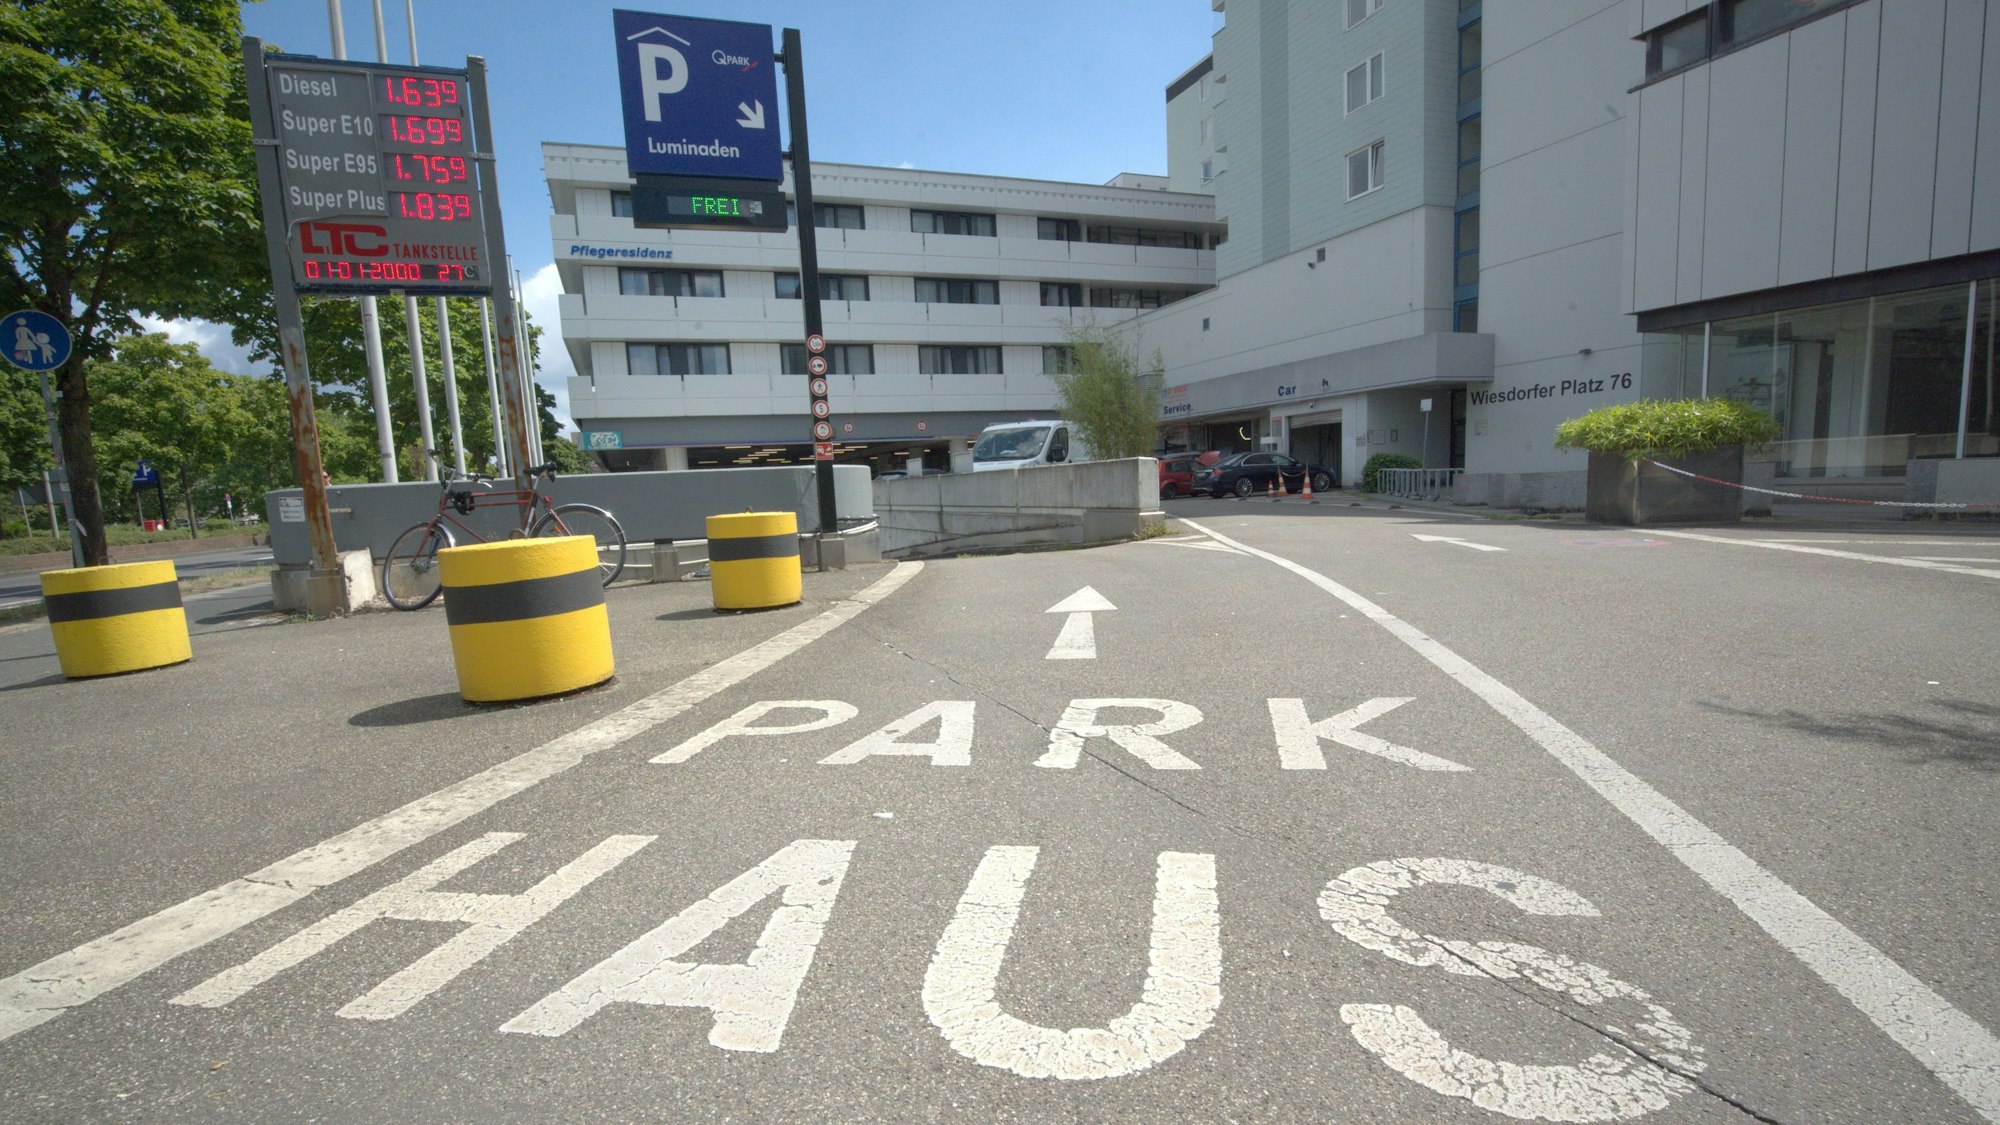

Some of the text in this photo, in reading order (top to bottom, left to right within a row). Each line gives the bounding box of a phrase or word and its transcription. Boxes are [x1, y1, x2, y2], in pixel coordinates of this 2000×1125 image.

[280, 74, 337, 97] Diesel
[638, 43, 688, 122] P
[283, 110, 336, 136] Super
[341, 115, 373, 136] E10
[648, 137, 740, 158] Luminaden
[286, 149, 340, 175] Super
[344, 153, 377, 175] E95
[290, 186, 343, 211] Super
[347, 190, 385, 211] Plus
[692, 196, 740, 215] FREI
[300, 222, 477, 261] LTC TANKSTELLE
[571, 245, 672, 259] Pflegeresidenz
[1278, 385, 1296, 396] Car
[1471, 372, 1632, 405] Wiesdorfer Platz 76
[819, 404, 824, 414] 5
[1164, 403, 1191, 415] Service
[648, 697, 1473, 774] PARK
[169, 829, 1707, 1123] HAUS
